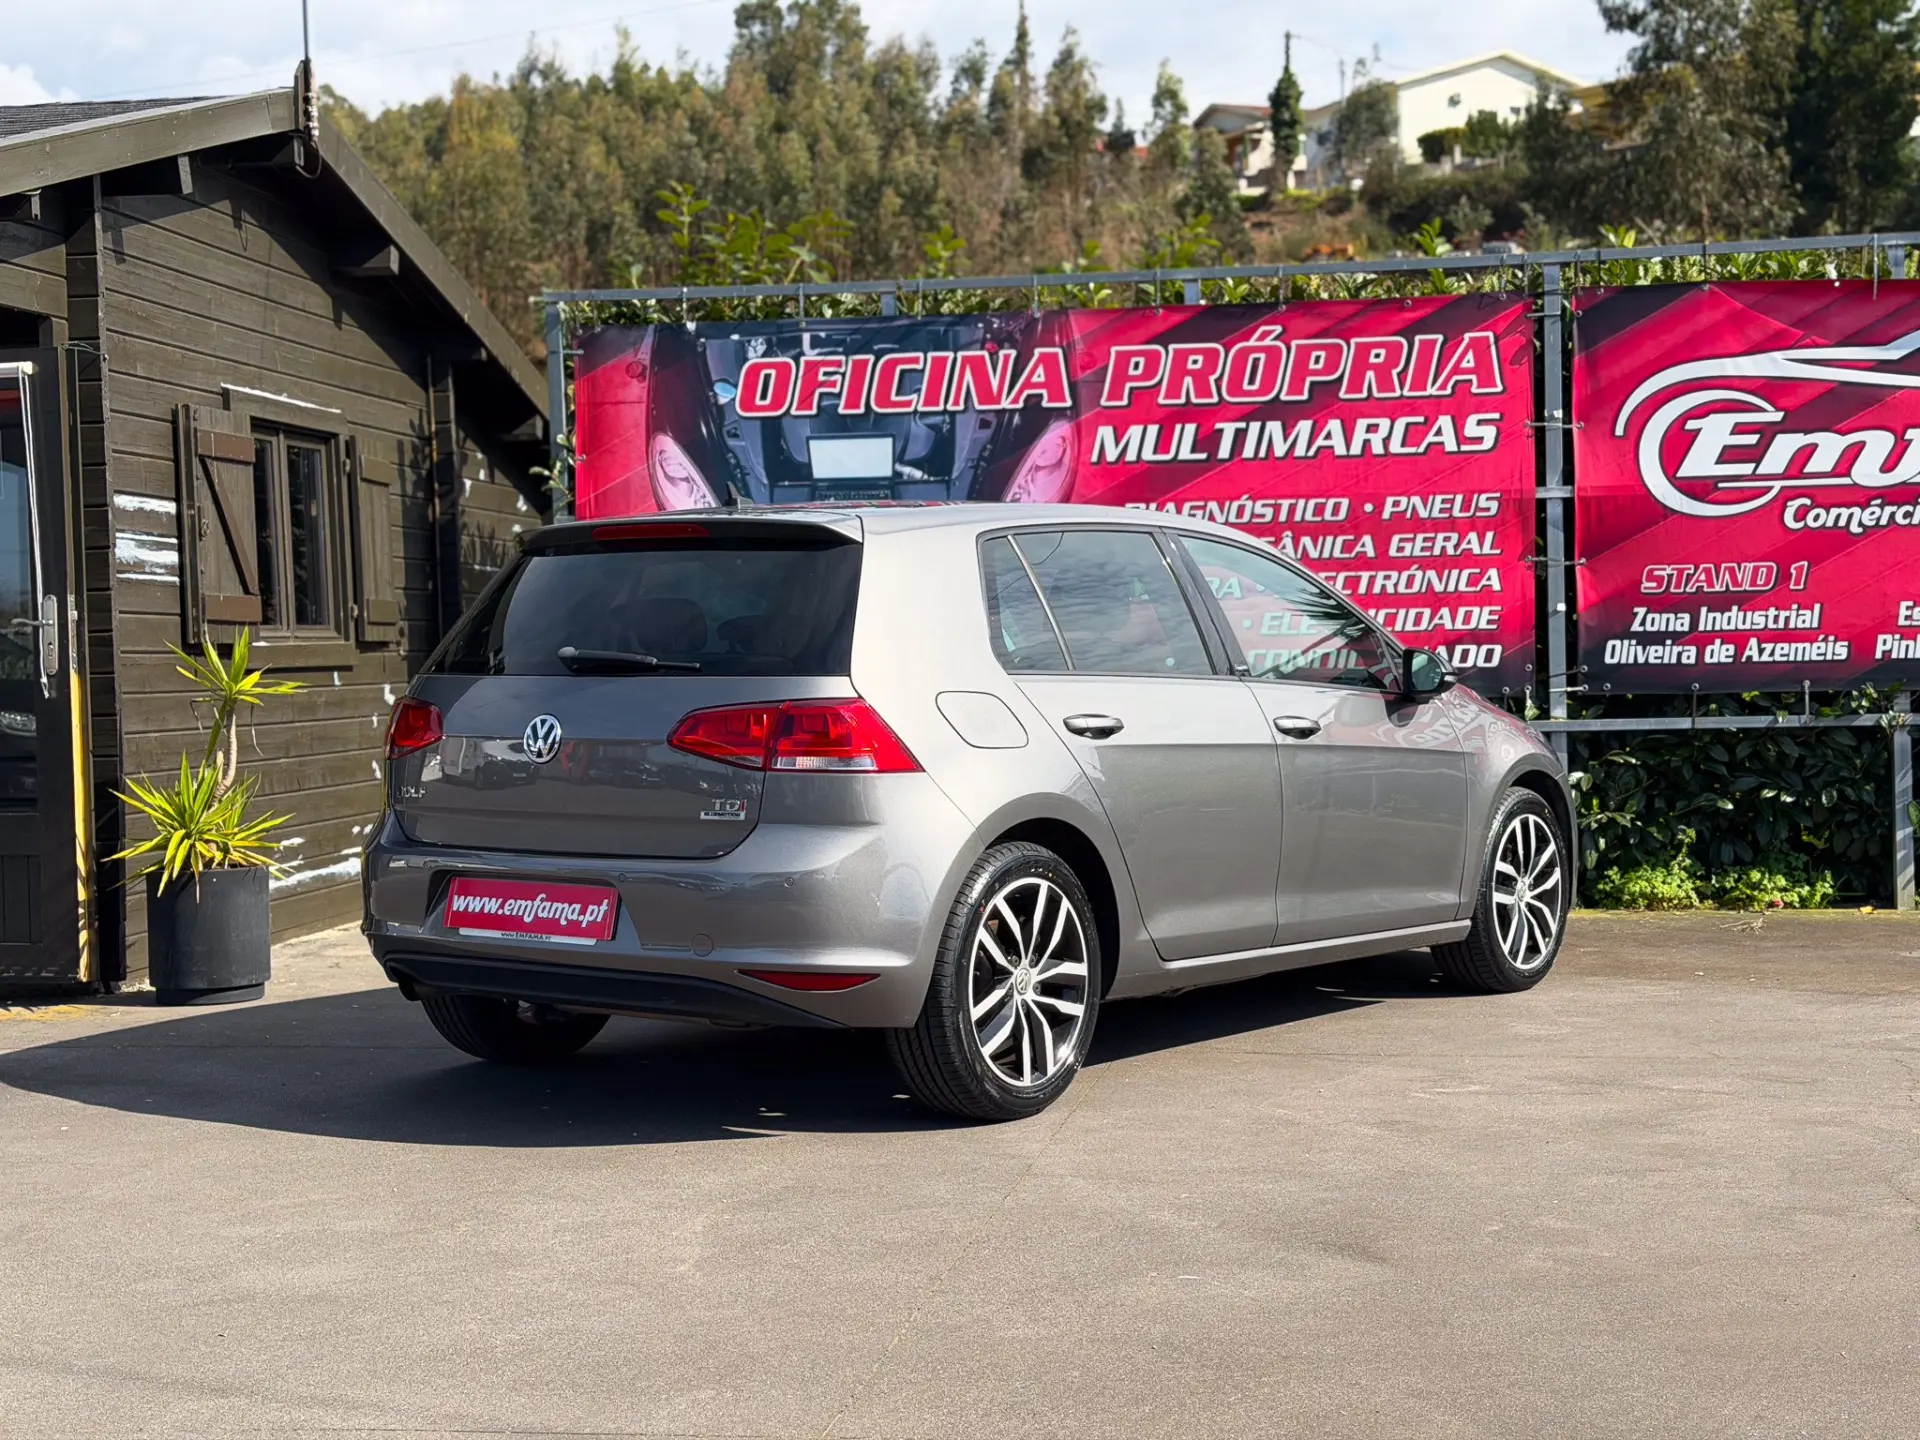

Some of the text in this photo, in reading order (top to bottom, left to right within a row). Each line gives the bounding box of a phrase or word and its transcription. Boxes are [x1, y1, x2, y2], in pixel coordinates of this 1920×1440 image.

[735, 325, 1505, 417] OFICINA PRÓPRIA
[1090, 412, 1501, 464] MULTIMARCAS
[1125, 493, 1501, 523] AGNÓSTICO PNEUS
[1259, 531, 1502, 560] ÂNICA GERAL
[1641, 561, 1809, 593] STAND 1
[1629, 603, 1821, 633] Zona Industrial
[1604, 634, 1849, 665] Oliveira de Azeméis
[712, 798, 747, 812] TDI
[452, 893, 608, 928] www.emfama.pt
